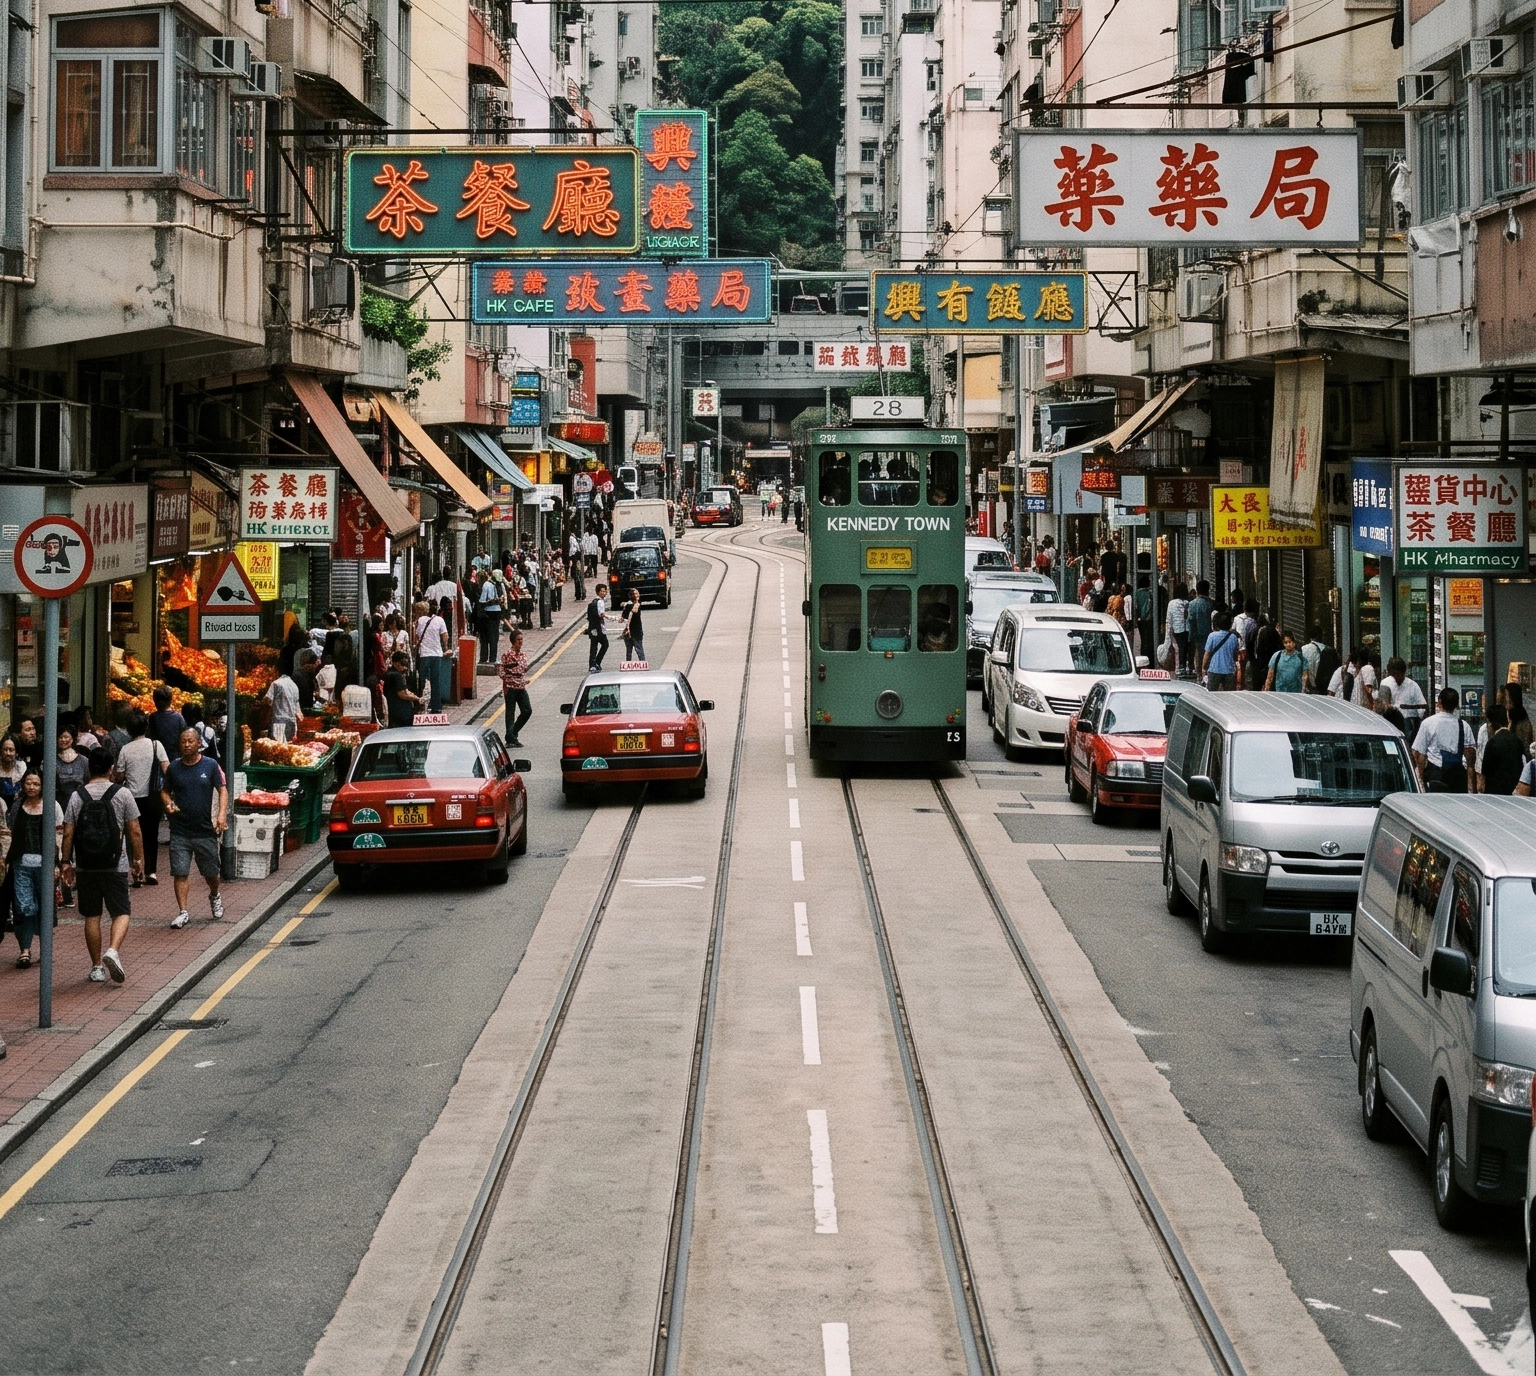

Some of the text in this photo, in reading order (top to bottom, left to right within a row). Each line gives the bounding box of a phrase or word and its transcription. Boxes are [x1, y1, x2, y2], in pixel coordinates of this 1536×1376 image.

[365, 159, 621, 239] 茶餐廳
[486, 299, 554, 313] HK CAFE
[872, 400, 903, 417] 28
[248, 472, 328, 498] 茶餐廳
[246, 522, 267, 535] HK
[827, 516, 951, 532] KENNEDY TOWN
[1406, 510, 1518, 543] 茶餐廳
[1404, 551, 1429, 566] HK
